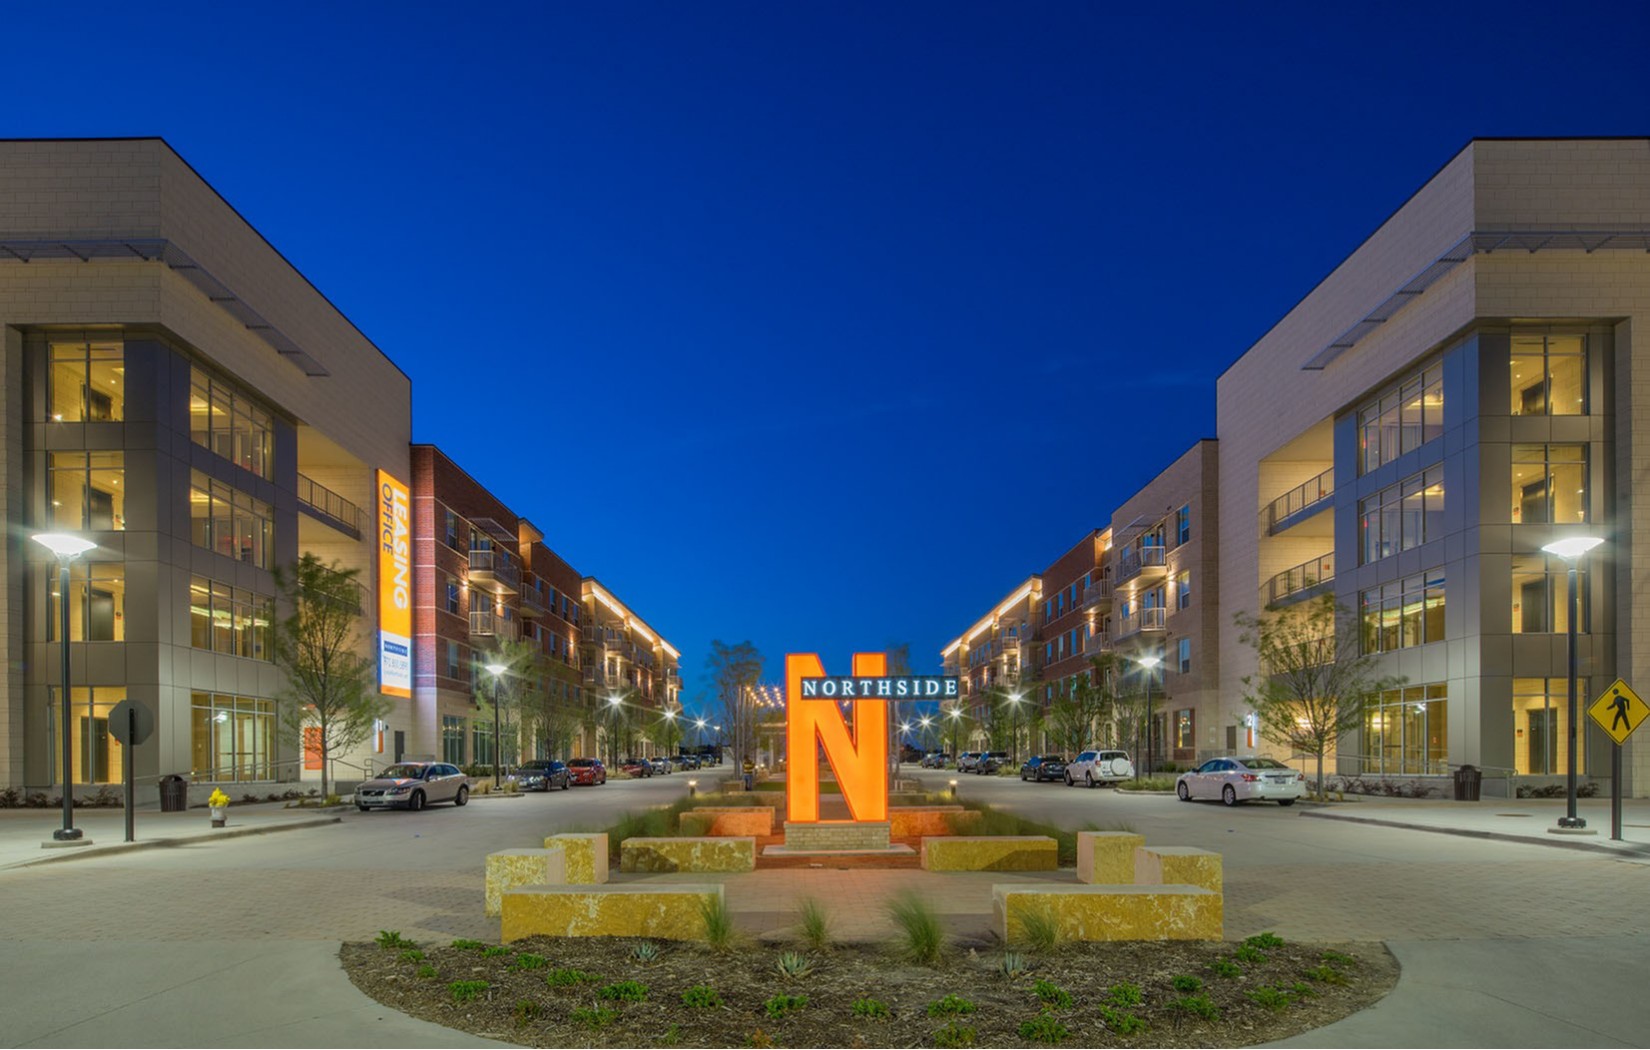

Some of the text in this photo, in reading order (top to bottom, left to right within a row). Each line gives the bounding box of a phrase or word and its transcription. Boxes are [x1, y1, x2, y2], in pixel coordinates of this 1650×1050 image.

[382, 483, 393, 556] OFFICE
[393, 487, 408, 609] LEASING
[802, 680, 958, 697] NORTHSIDE
[786, 653, 889, 822] N
